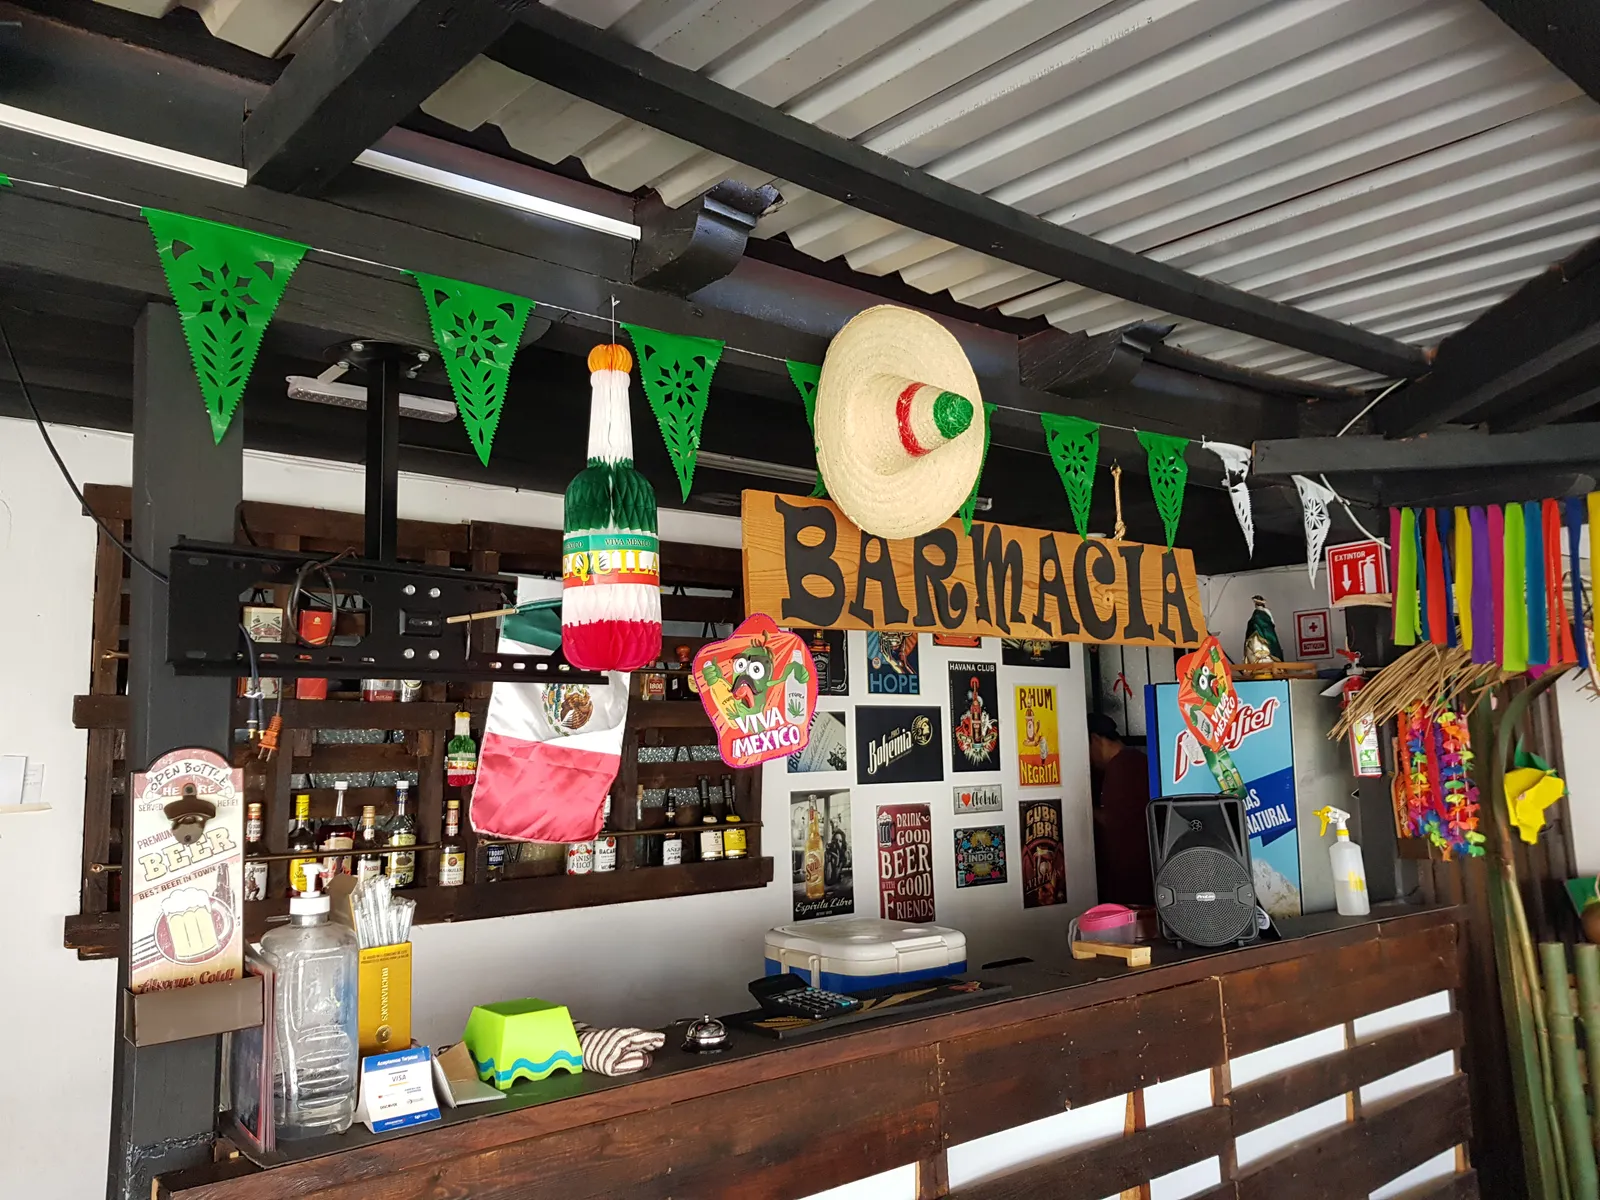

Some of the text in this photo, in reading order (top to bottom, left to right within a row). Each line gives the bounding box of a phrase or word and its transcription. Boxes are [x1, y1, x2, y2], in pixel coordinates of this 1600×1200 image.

[605, 538, 625, 546] VIVA
[563, 550, 660, 582] EQUILA
[1334, 551, 1366, 562] EXTINTOR
[775, 495, 1198, 642] BARMACIA
[949, 663, 995, 672] HAVANA CLUB
[869, 673, 918, 693] HOPE
[1019, 688, 1053, 711] RHUM
[1211, 692, 1230, 724] VIVA
[735, 706, 785, 734] VIVA
[1213, 696, 1236, 744] MEXICO
[867, 728, 912, 775] Bohemia
[150, 762, 229, 791] OPEN BOTTLE
[1020, 760, 1059, 787] NEGRITA
[138, 804, 163, 812] SERVED
[957, 792, 961, 809] I
[896, 812, 921, 828] DRINK
[1026, 806, 1058, 826] CUBA
[1247, 803, 1292, 835] NATURAL
[137, 829, 174, 850] PREMIUM
[896, 829, 931, 846] GOOD
[1025, 822, 1060, 845] LIBRE
[138, 827, 236, 882] BEER
[880, 843, 931, 880] BEER
[968, 852, 994, 863] INDIO
[138, 866, 216, 901] BEST BEER IN TOWN
[897, 872, 932, 897] GOOD
[830, 897, 853, 908] Libre
[883, 890, 934, 920] FRIENDS
[199, 967, 236, 985] Cold!
[391, 1074, 407, 1082] VISA
